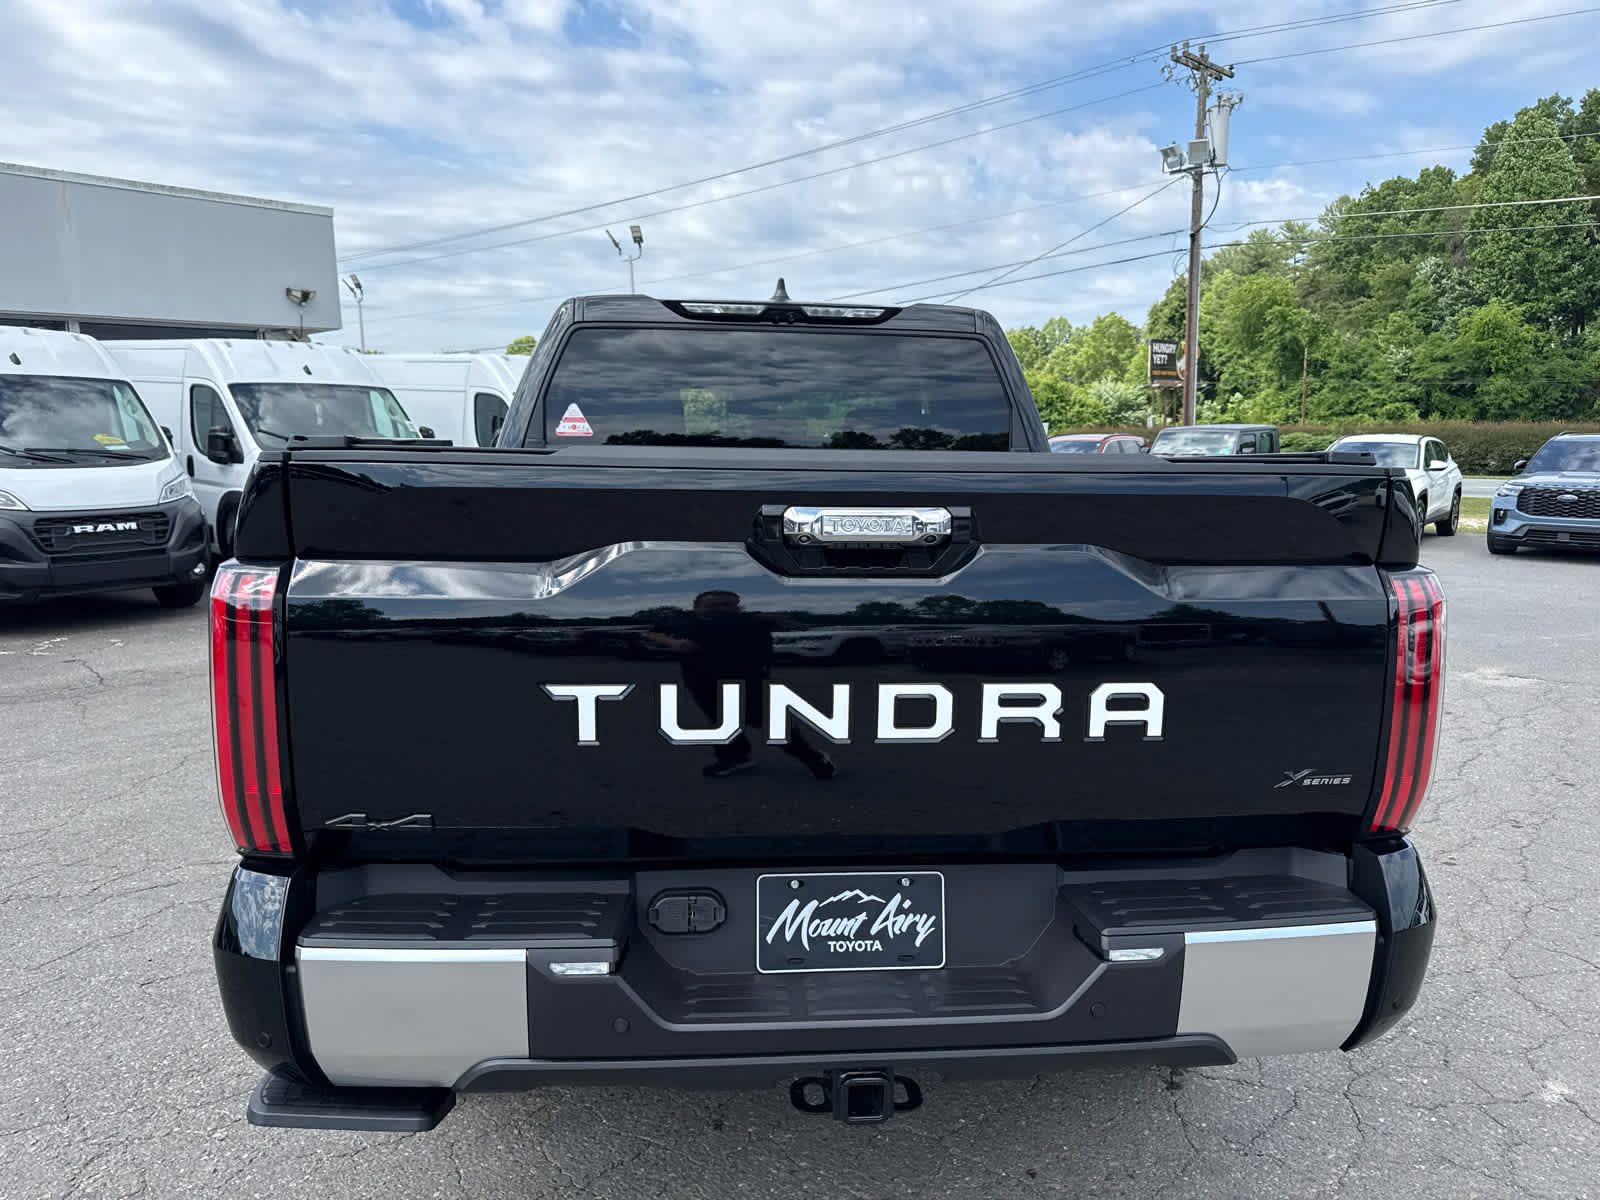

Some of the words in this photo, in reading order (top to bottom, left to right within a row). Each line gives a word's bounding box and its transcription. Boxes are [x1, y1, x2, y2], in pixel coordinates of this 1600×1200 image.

[1152, 343, 1177, 354] HUNGRY
[73, 522, 137, 533] RAM
[830, 518, 906, 532] TOYOTA
[540, 682, 1165, 746] TUNDRA
[766, 899, 868, 951] Mount
[870, 893, 936, 948] Airy
[828, 940, 883, 952] TOYOTA
